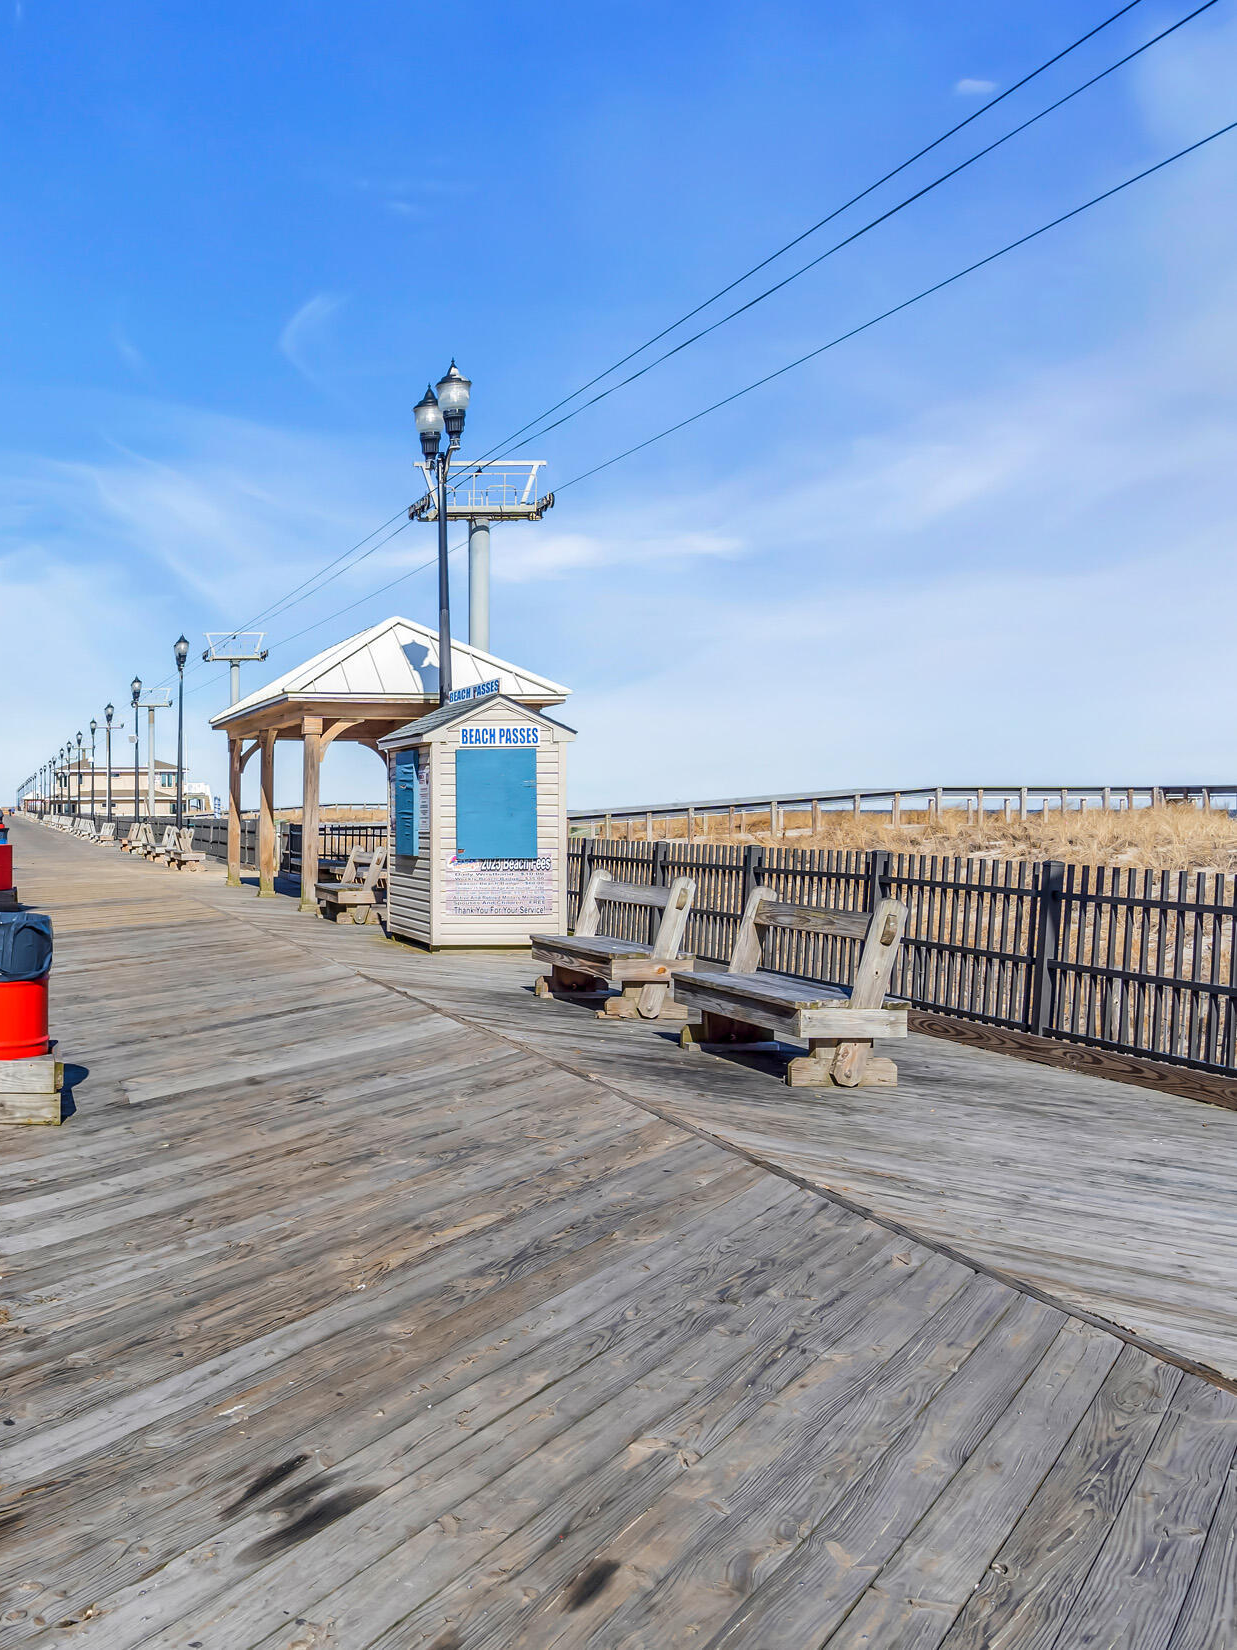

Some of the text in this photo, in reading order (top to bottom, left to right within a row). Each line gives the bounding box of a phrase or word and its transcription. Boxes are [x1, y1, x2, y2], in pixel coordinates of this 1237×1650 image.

[449, 679, 499, 703] BEACH PASSES
[462, 727, 539, 744] BEACH PASSES
[530, 857, 551, 871] Fees
[454, 906, 546, 914] Thank You For Your Service!
